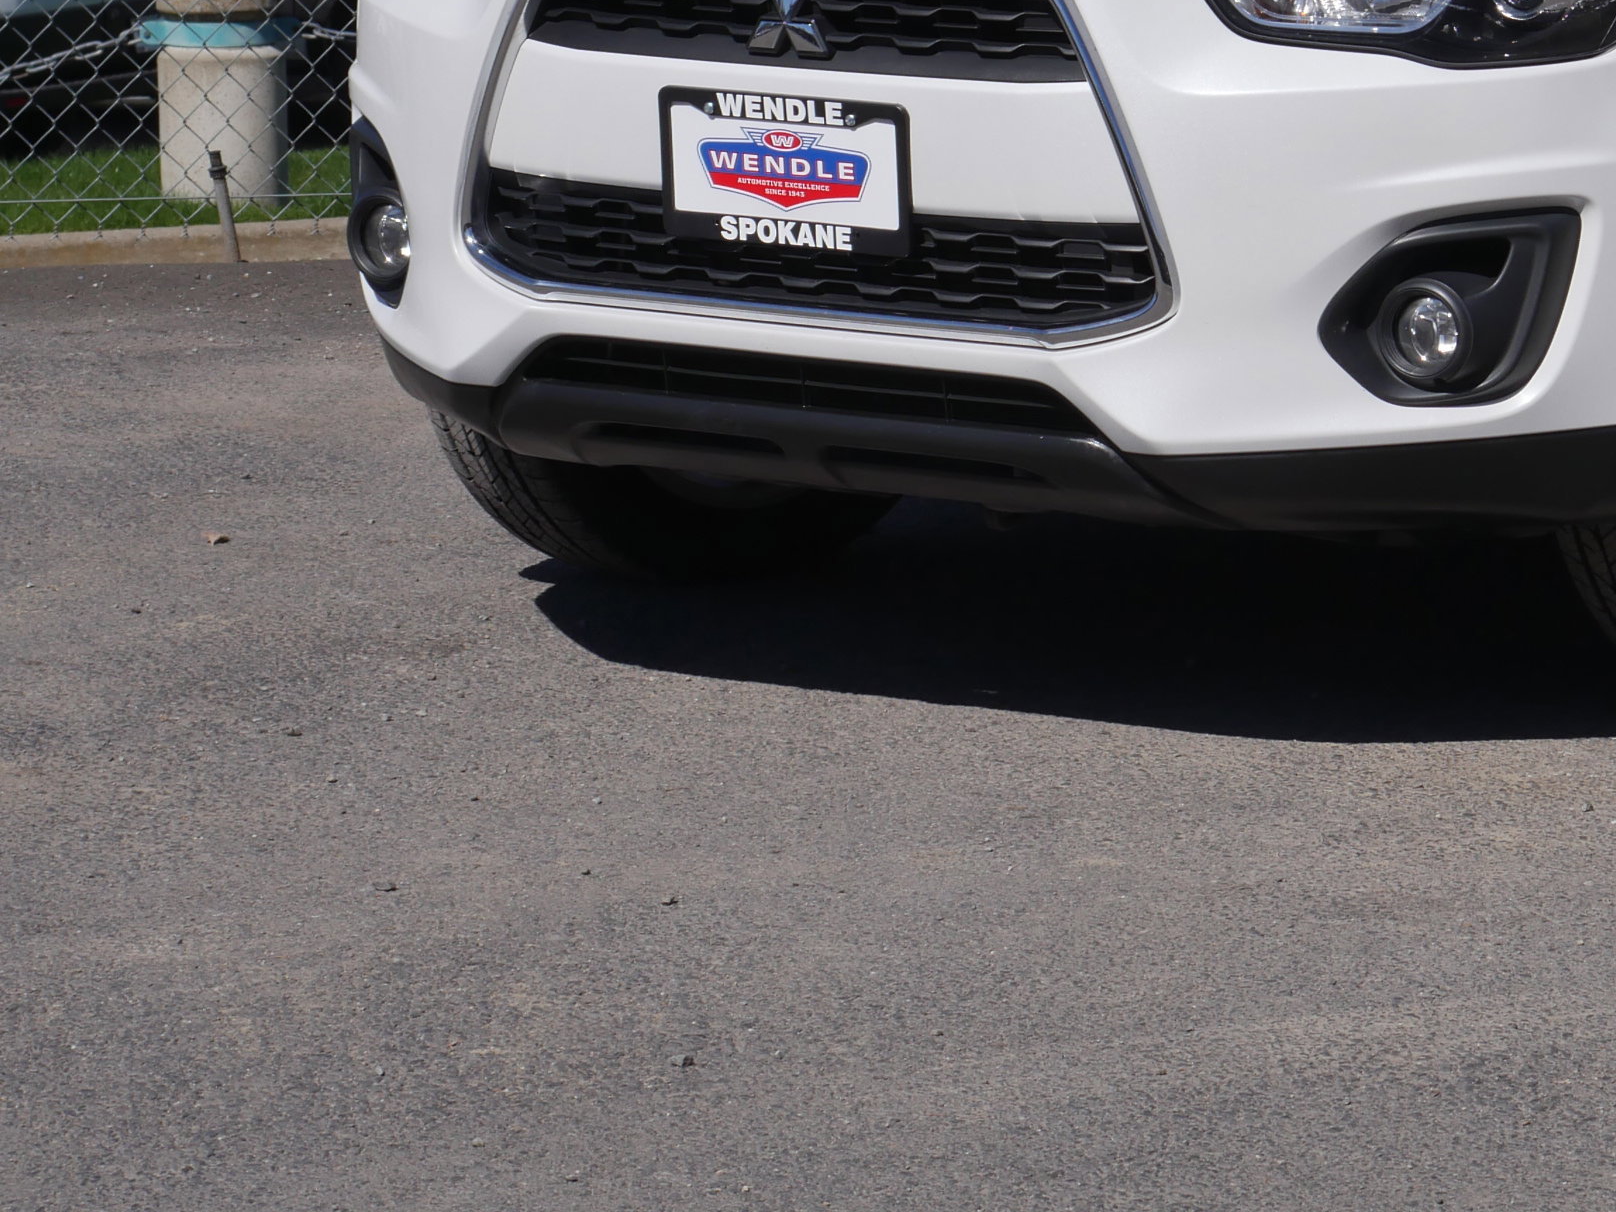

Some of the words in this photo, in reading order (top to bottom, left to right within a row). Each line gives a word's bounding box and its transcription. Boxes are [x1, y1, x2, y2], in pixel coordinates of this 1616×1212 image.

[716, 92, 844, 126] WENDLE
[708, 149, 855, 181] WENDLE
[737, 177, 783, 188] AUTOMOTIVE
[784, 181, 830, 192] EXCELLENCE
[764, 188, 787, 196] SINCE
[788, 190, 806, 198] 1943
[720, 215, 853, 251] SPOKANE
